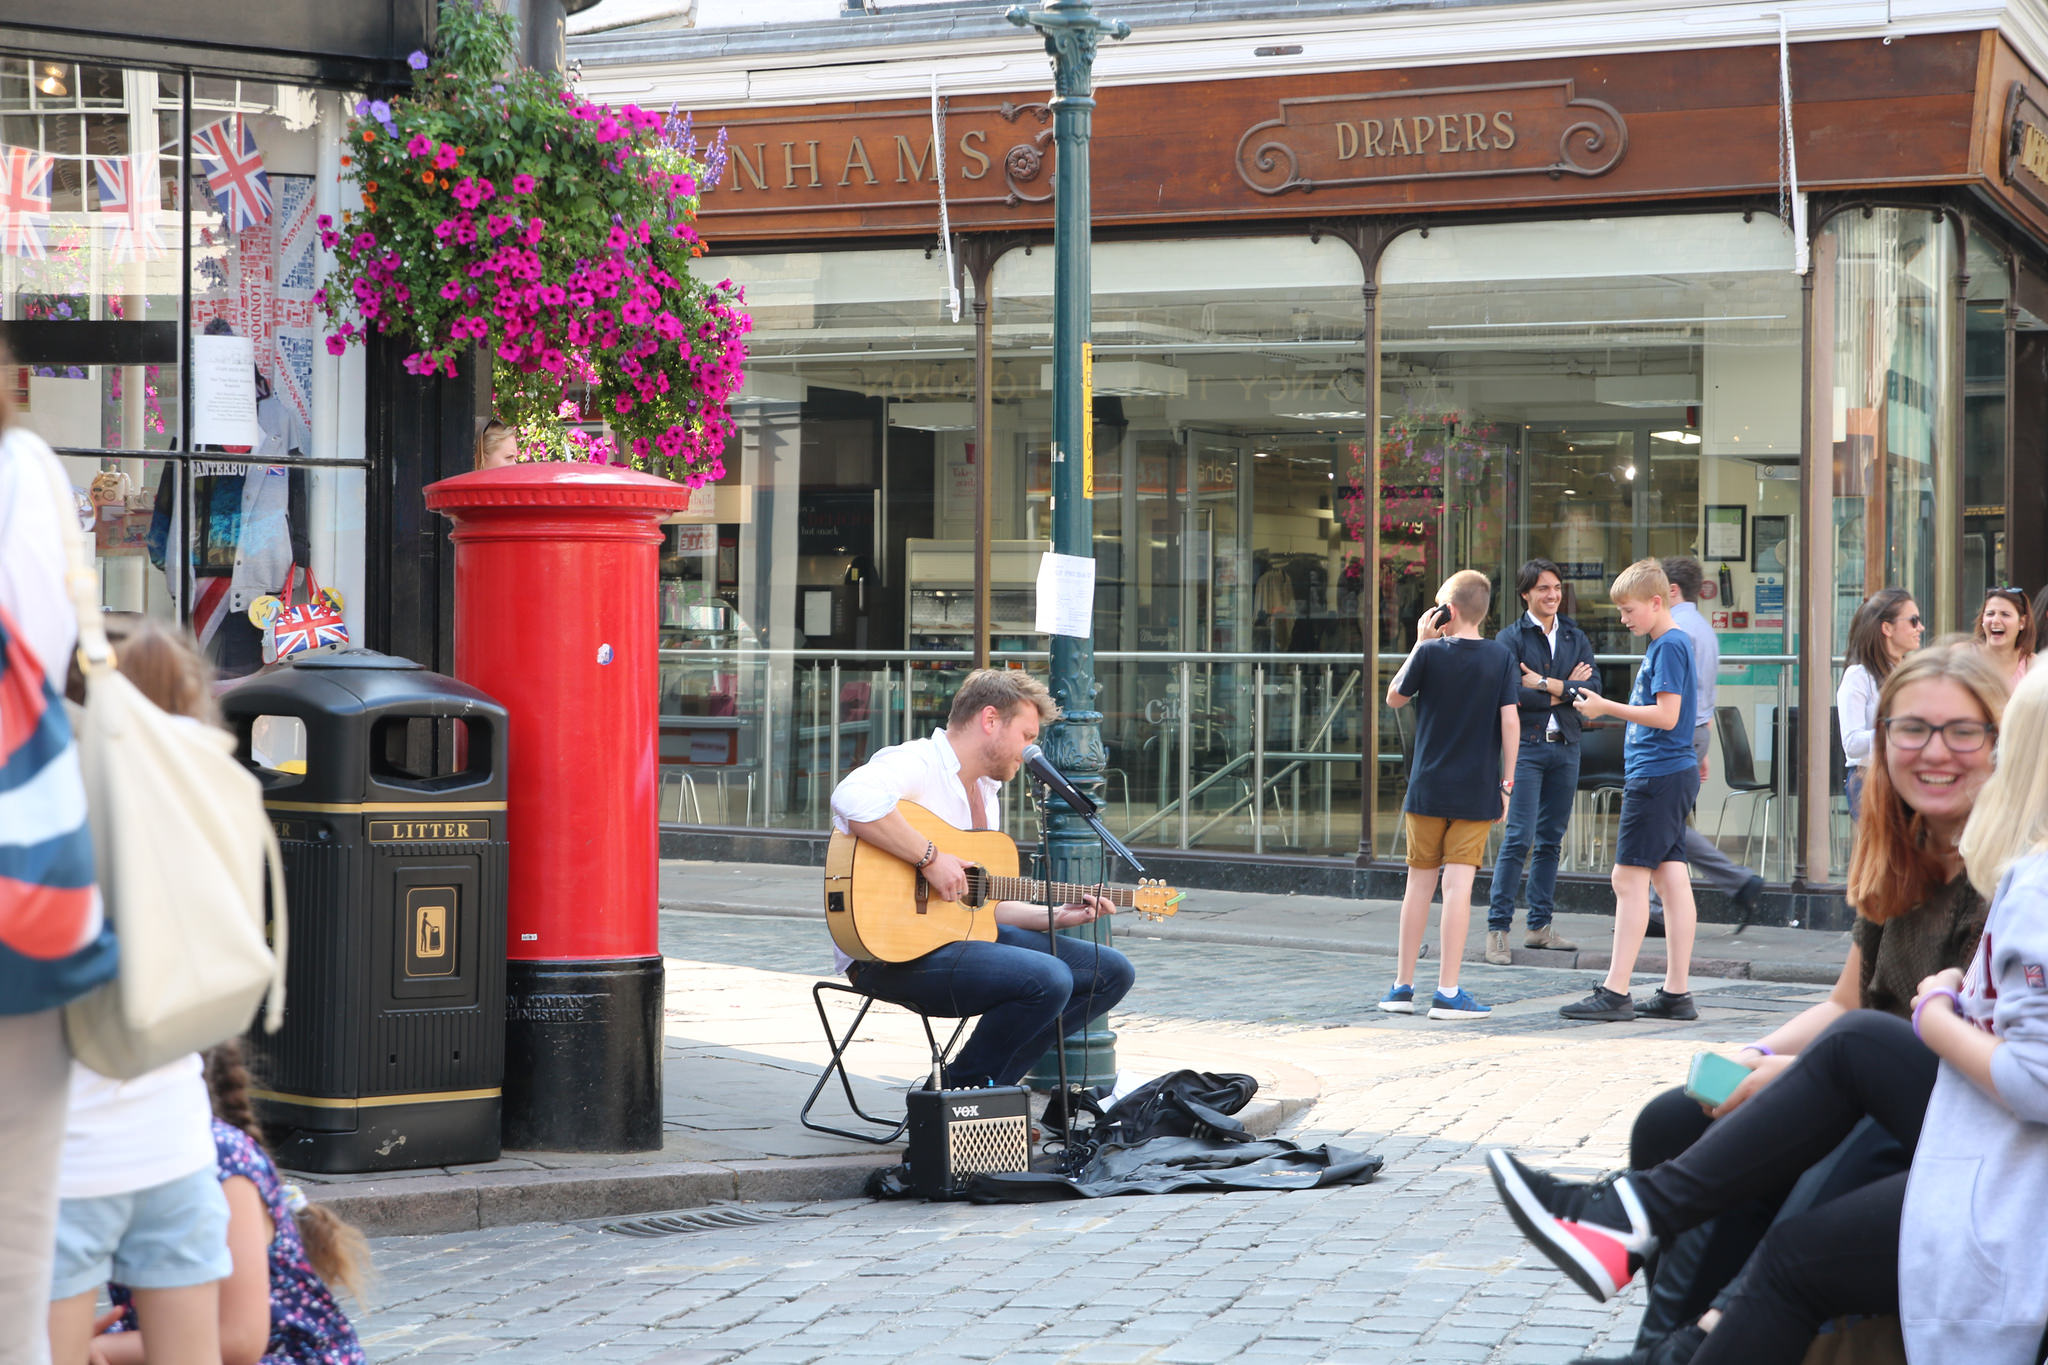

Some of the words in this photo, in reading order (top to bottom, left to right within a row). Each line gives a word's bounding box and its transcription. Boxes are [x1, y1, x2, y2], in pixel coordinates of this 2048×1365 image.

[1335, 111, 1515, 161] DRAPERS
[698, 129, 992, 192] NHAMS
[250, 284, 263, 348] LONDON
[193, 460, 247, 477] ANTERBU
[392, 823, 469, 839] LITTER
[952, 1105, 979, 1118] VOX
